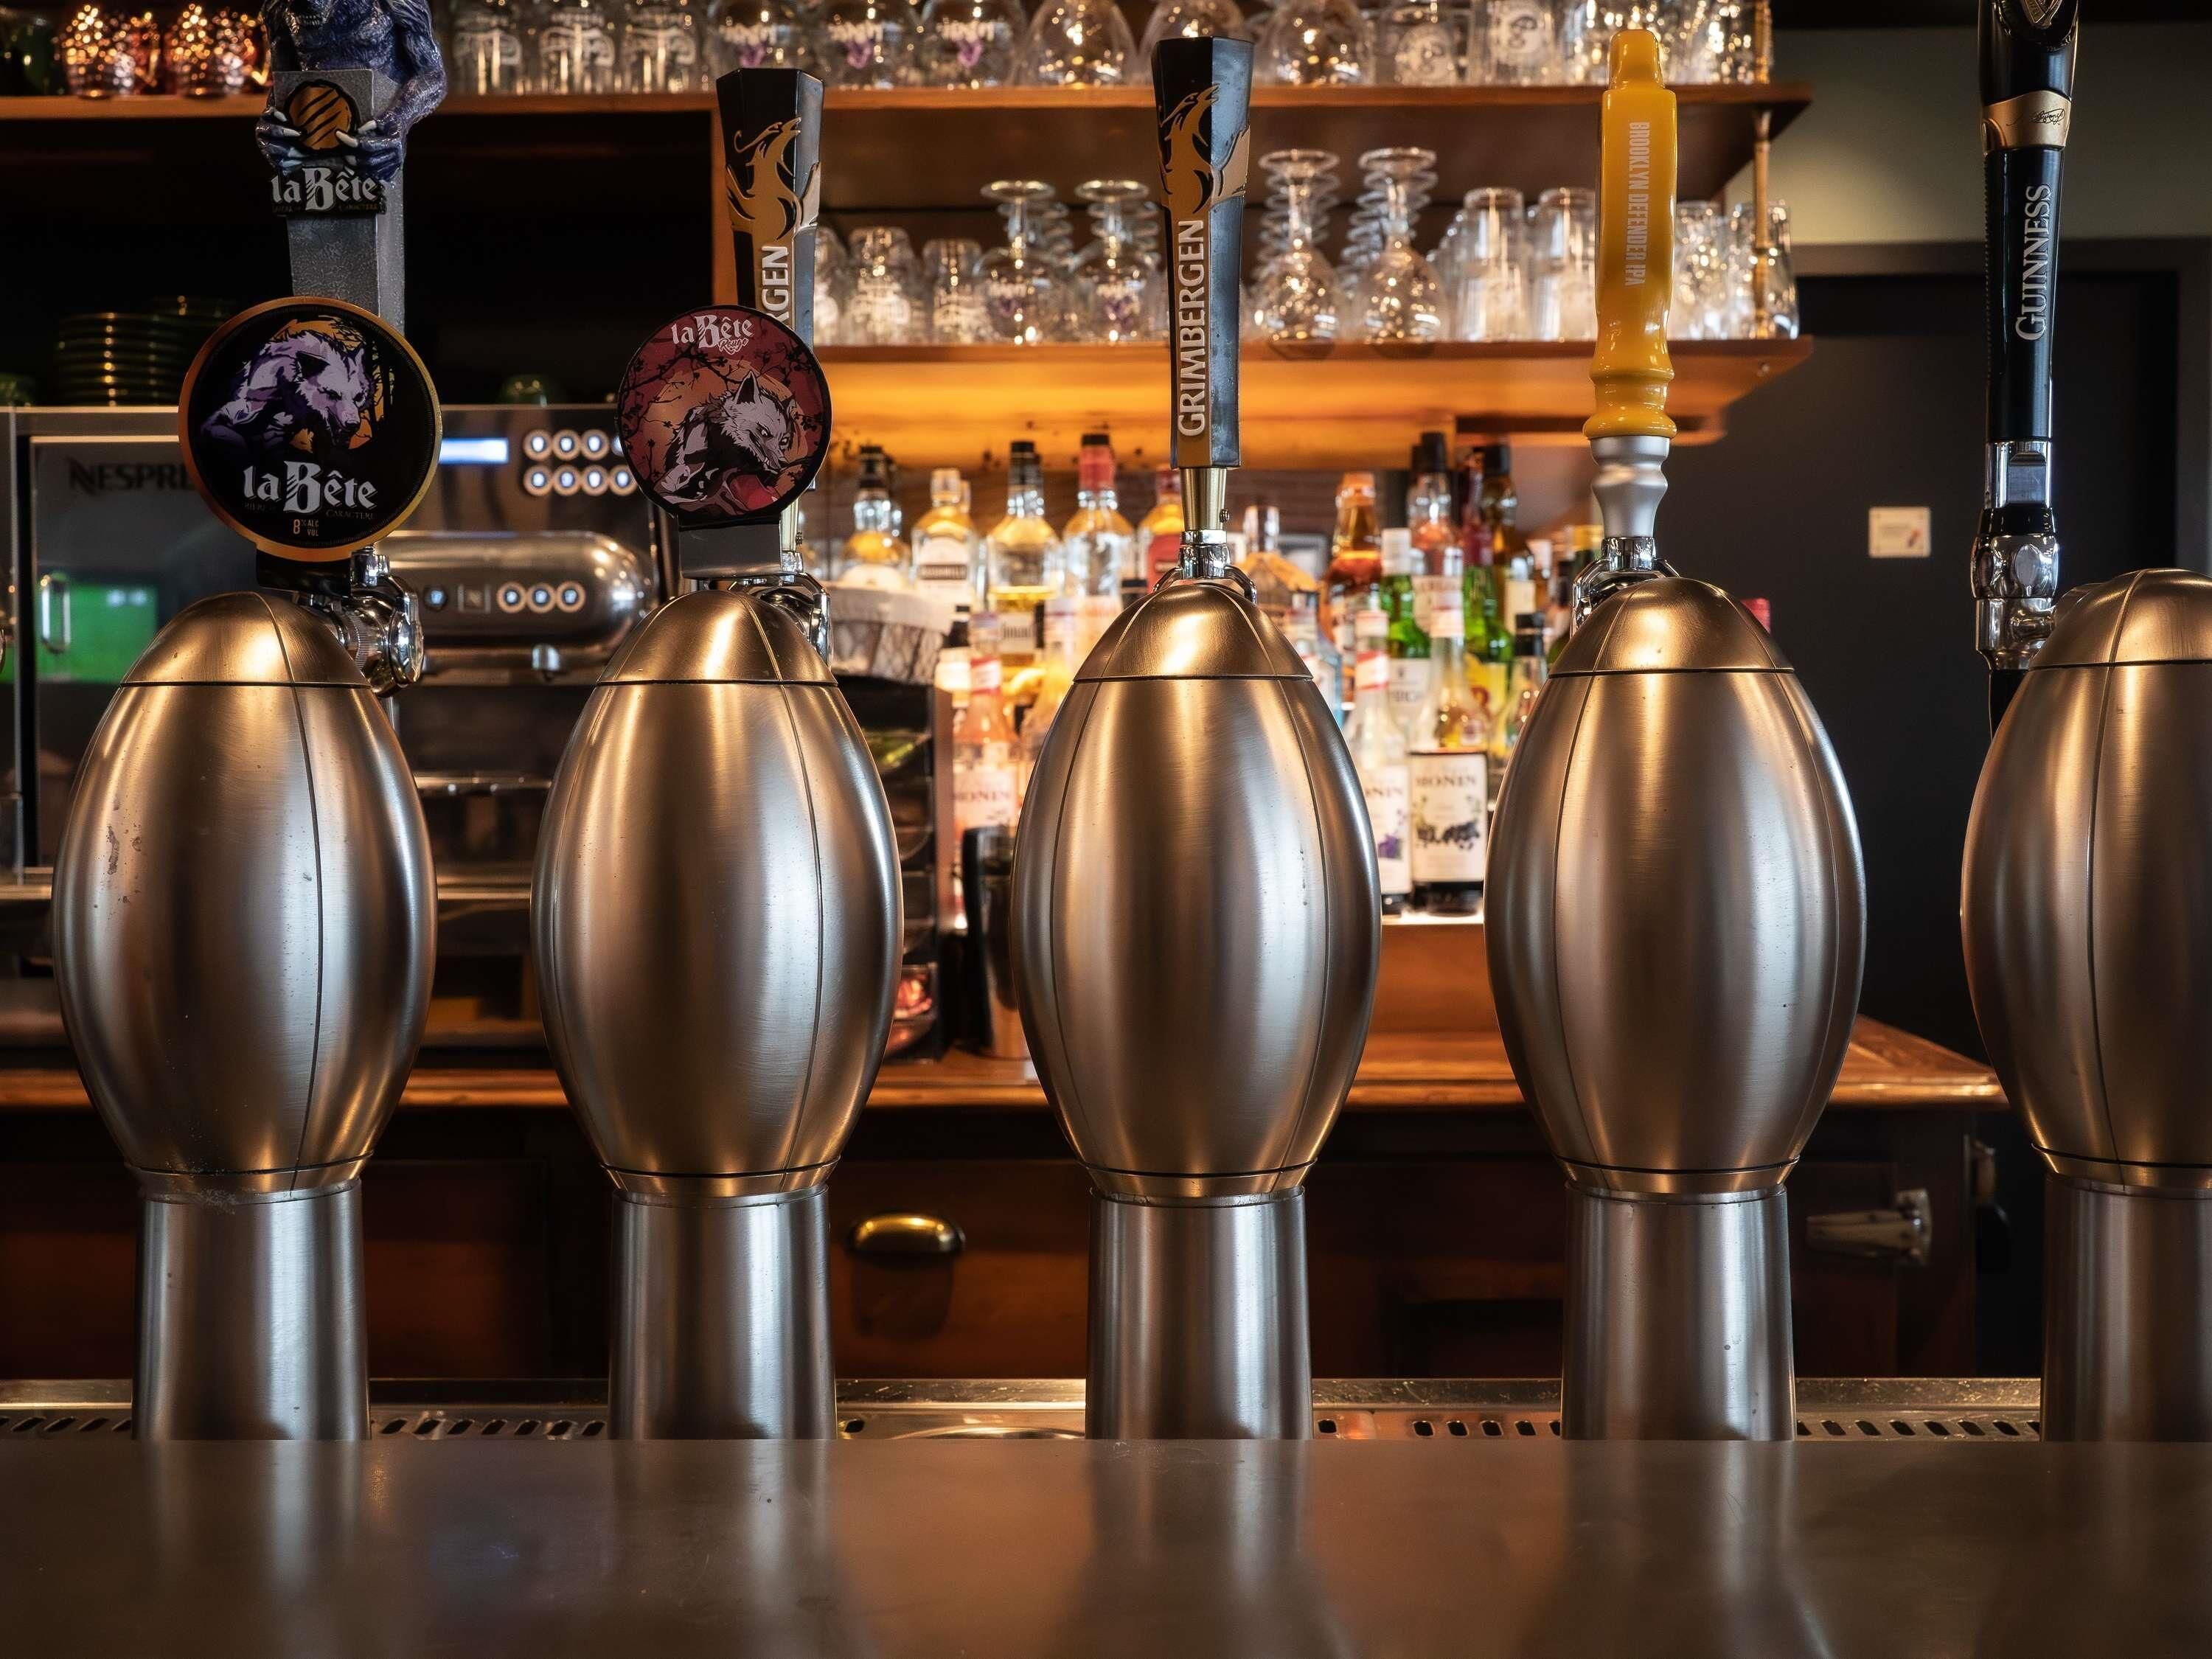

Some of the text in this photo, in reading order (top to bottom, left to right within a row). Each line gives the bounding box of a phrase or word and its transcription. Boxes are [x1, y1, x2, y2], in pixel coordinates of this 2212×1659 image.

[271, 175, 302, 204] la
[1624, 121, 1650, 286] BROOKLYN DEFENDER IPA
[2015, 184, 2052, 341] GUINNESS
[671, 314, 754, 349] la Bête
[1178, 220, 1206, 437] GRIMBERGEN
[243, 460, 378, 514] la Bête
